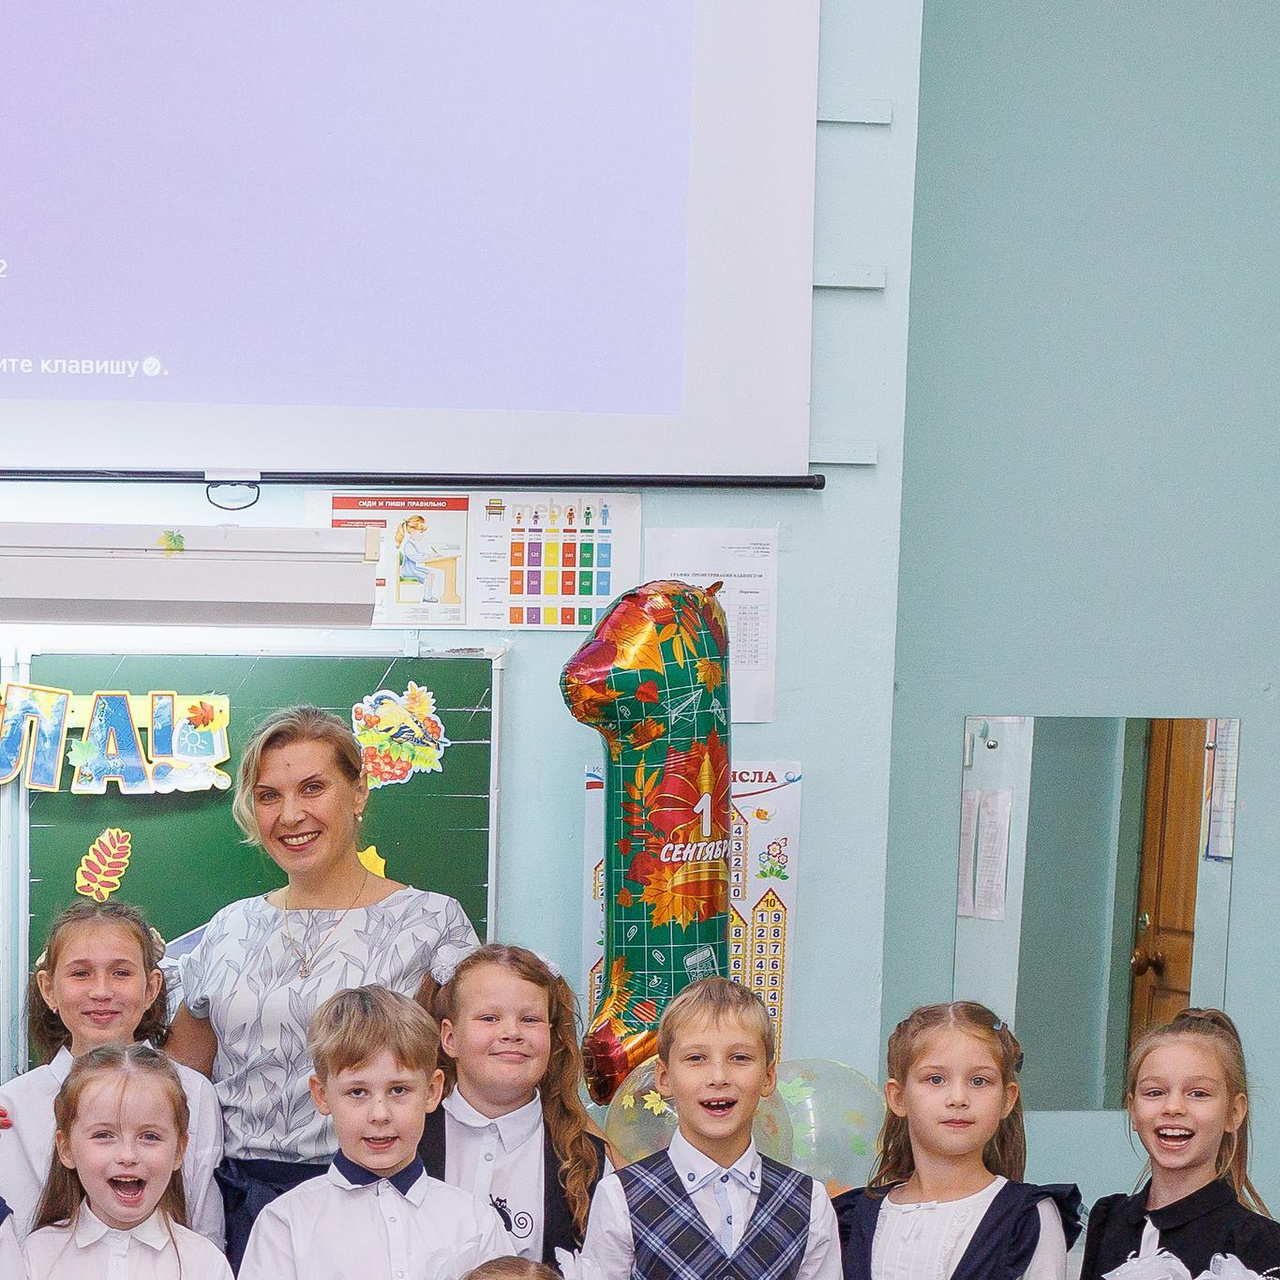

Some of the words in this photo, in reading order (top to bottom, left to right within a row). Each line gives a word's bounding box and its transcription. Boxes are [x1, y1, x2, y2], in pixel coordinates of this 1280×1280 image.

[358, 500, 377, 508] СИДИ
[385, 500, 406, 508] ПИШИ
[693, 791, 712, 837] 1
[734, 826, 742, 835] 4
[734, 842, 742, 851] 3
[734, 858, 741, 867] 2
[733, 873, 740, 882] 1
[733, 888, 740, 897] 0
[764, 899, 776, 908] 10
[758, 913, 765, 922] 1
[773, 913, 781, 922] 9
[734, 928, 742, 938] 8
[757, 928, 765, 938] 2
[773, 928, 780, 938] 8
[733, 944, 741, 954] 7
[757, 944, 764, 954] 3
[772, 944, 779, 954] 7
[733, 960, 741, 969] 6
[756, 960, 764, 970] 4
[771, 960, 779, 970] 6
[756, 976, 763, 986] 5
[770, 976, 778, 986] 5
[770, 992, 778, 1001] 4
[770, 1007, 777, 1017] 3
